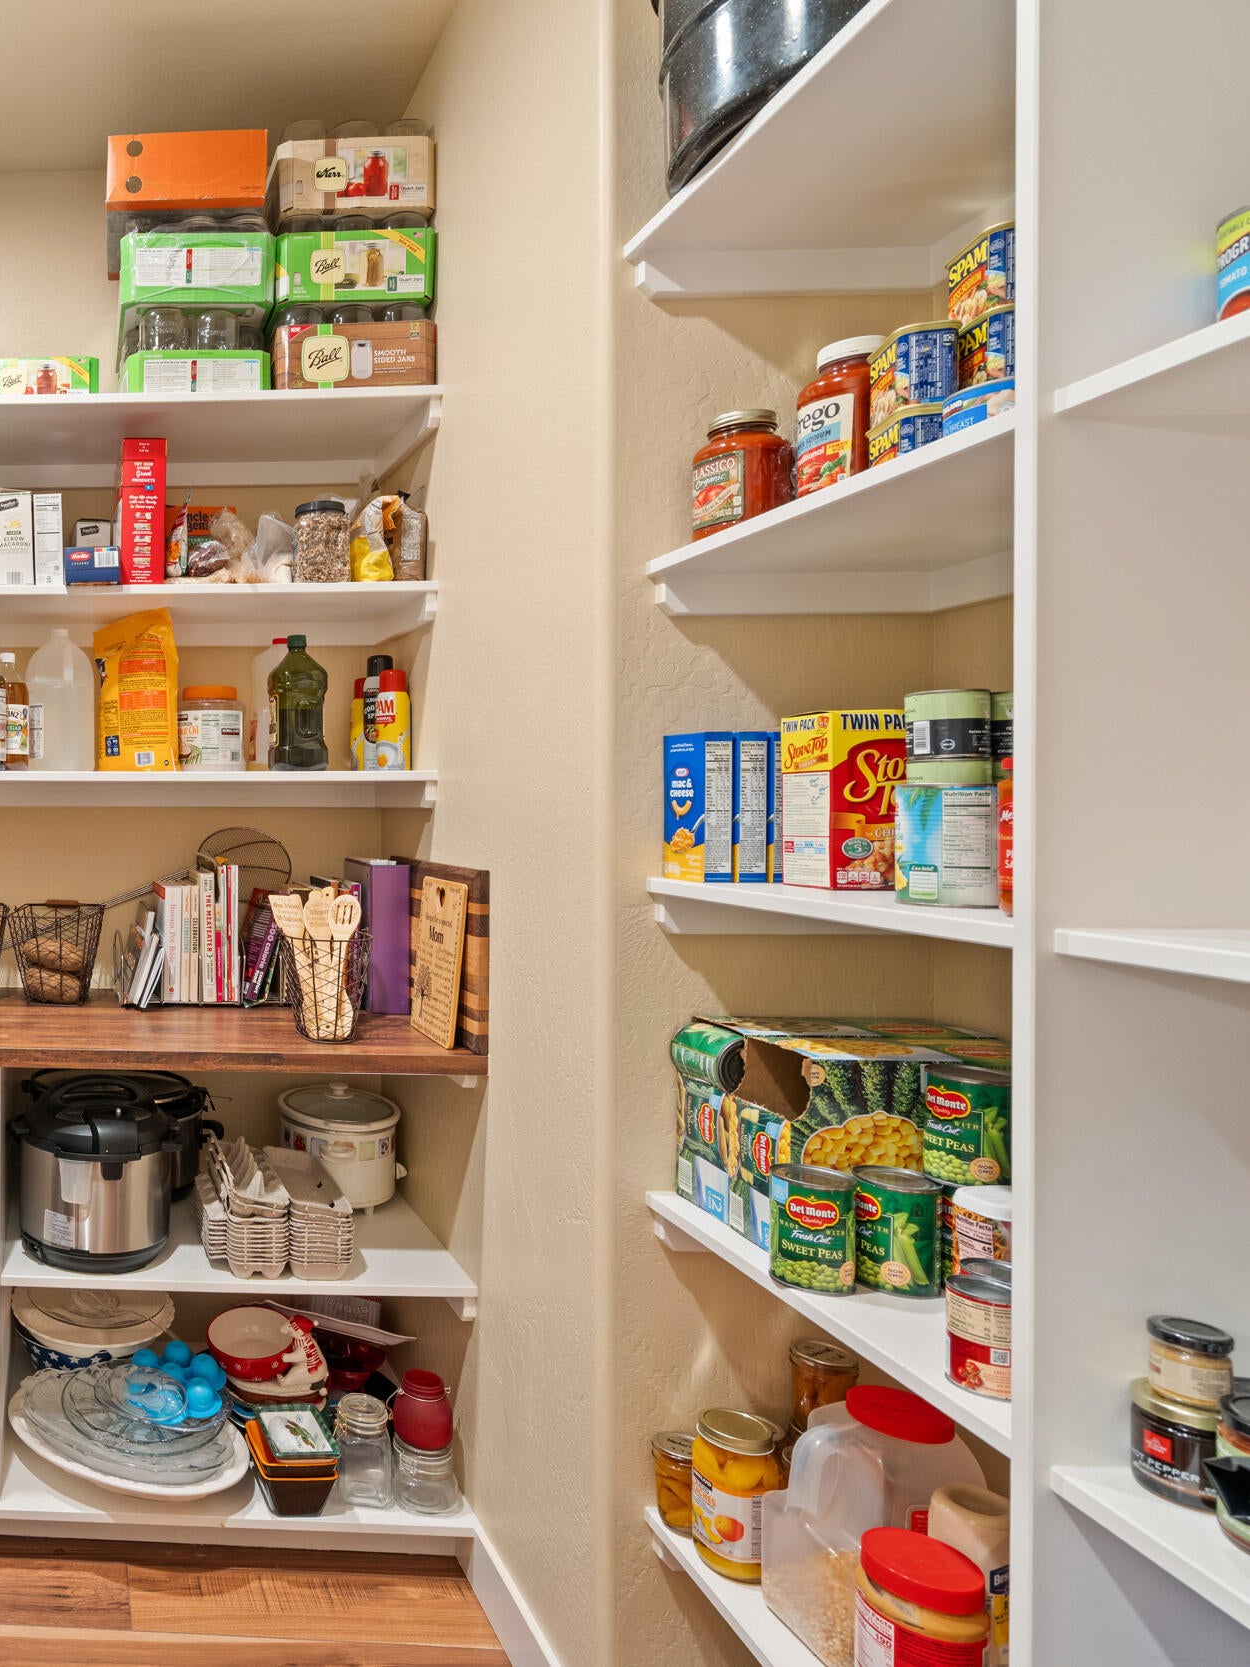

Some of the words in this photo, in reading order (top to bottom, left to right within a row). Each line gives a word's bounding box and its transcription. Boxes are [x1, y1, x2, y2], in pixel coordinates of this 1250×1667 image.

[316, 167, 341, 178] Kerr
[315, 257, 341, 274] Ball
[949, 240, 988, 287] SPAM
[410, 322, 420, 330] 12
[308, 346, 343, 369] Ball
[373, 349, 407, 357] SMOOTH
[373, 356, 396, 364] SIDED
[397, 355, 416, 363] JARS
[870, 343, 897, 384] SPAM
[869, 423, 900, 460] SPAM
[695, 473, 726, 490] Organic
[189, 725, 198, 735] Oil
[783, 720, 799, 732] TWIN
[800, 718, 816, 731] PACK
[840, 713, 880, 731] TWIN
[843, 749, 907, 803] Sto
[205, 909, 213, 953] MEATEATER
[429, 925, 444, 944] Mom
[258, 942, 271, 969] calorie
[936, 1096, 967, 1111] Monte
[704, 1118, 712, 1142] Monte
[953, 1120, 979, 1130] WITH
[759, 1134, 767, 1147] Del
[945, 1138, 975, 1153] PEAS
[759, 1148, 768, 1174] Monte
[711, 1194, 722, 1211] 12
[789, 1202, 805, 1213] Del
[805, 1206, 836, 1219] Monte
[779, 1218, 800, 1230] MADE
[866, 1223, 890, 1234] WITH
[956, 1214, 974, 1228] Nutrition
[975, 1220, 992, 1232] Facts
[791, 1229, 814, 1243] Fresh
[825, 1229, 845, 1237] WITH
[781, 1238, 816, 1257] SWEET
[817, 1247, 843, 1260] PEAS
[860, 1241, 885, 1256] PEAS
[982, 1246, 993, 1254] 45
[887, 1272, 903, 1280] GMO
[1147, 1458, 1201, 1483] PEPPER
[871, 1611, 892, 1630] Facts
[874, 1632, 893, 1649] 190
